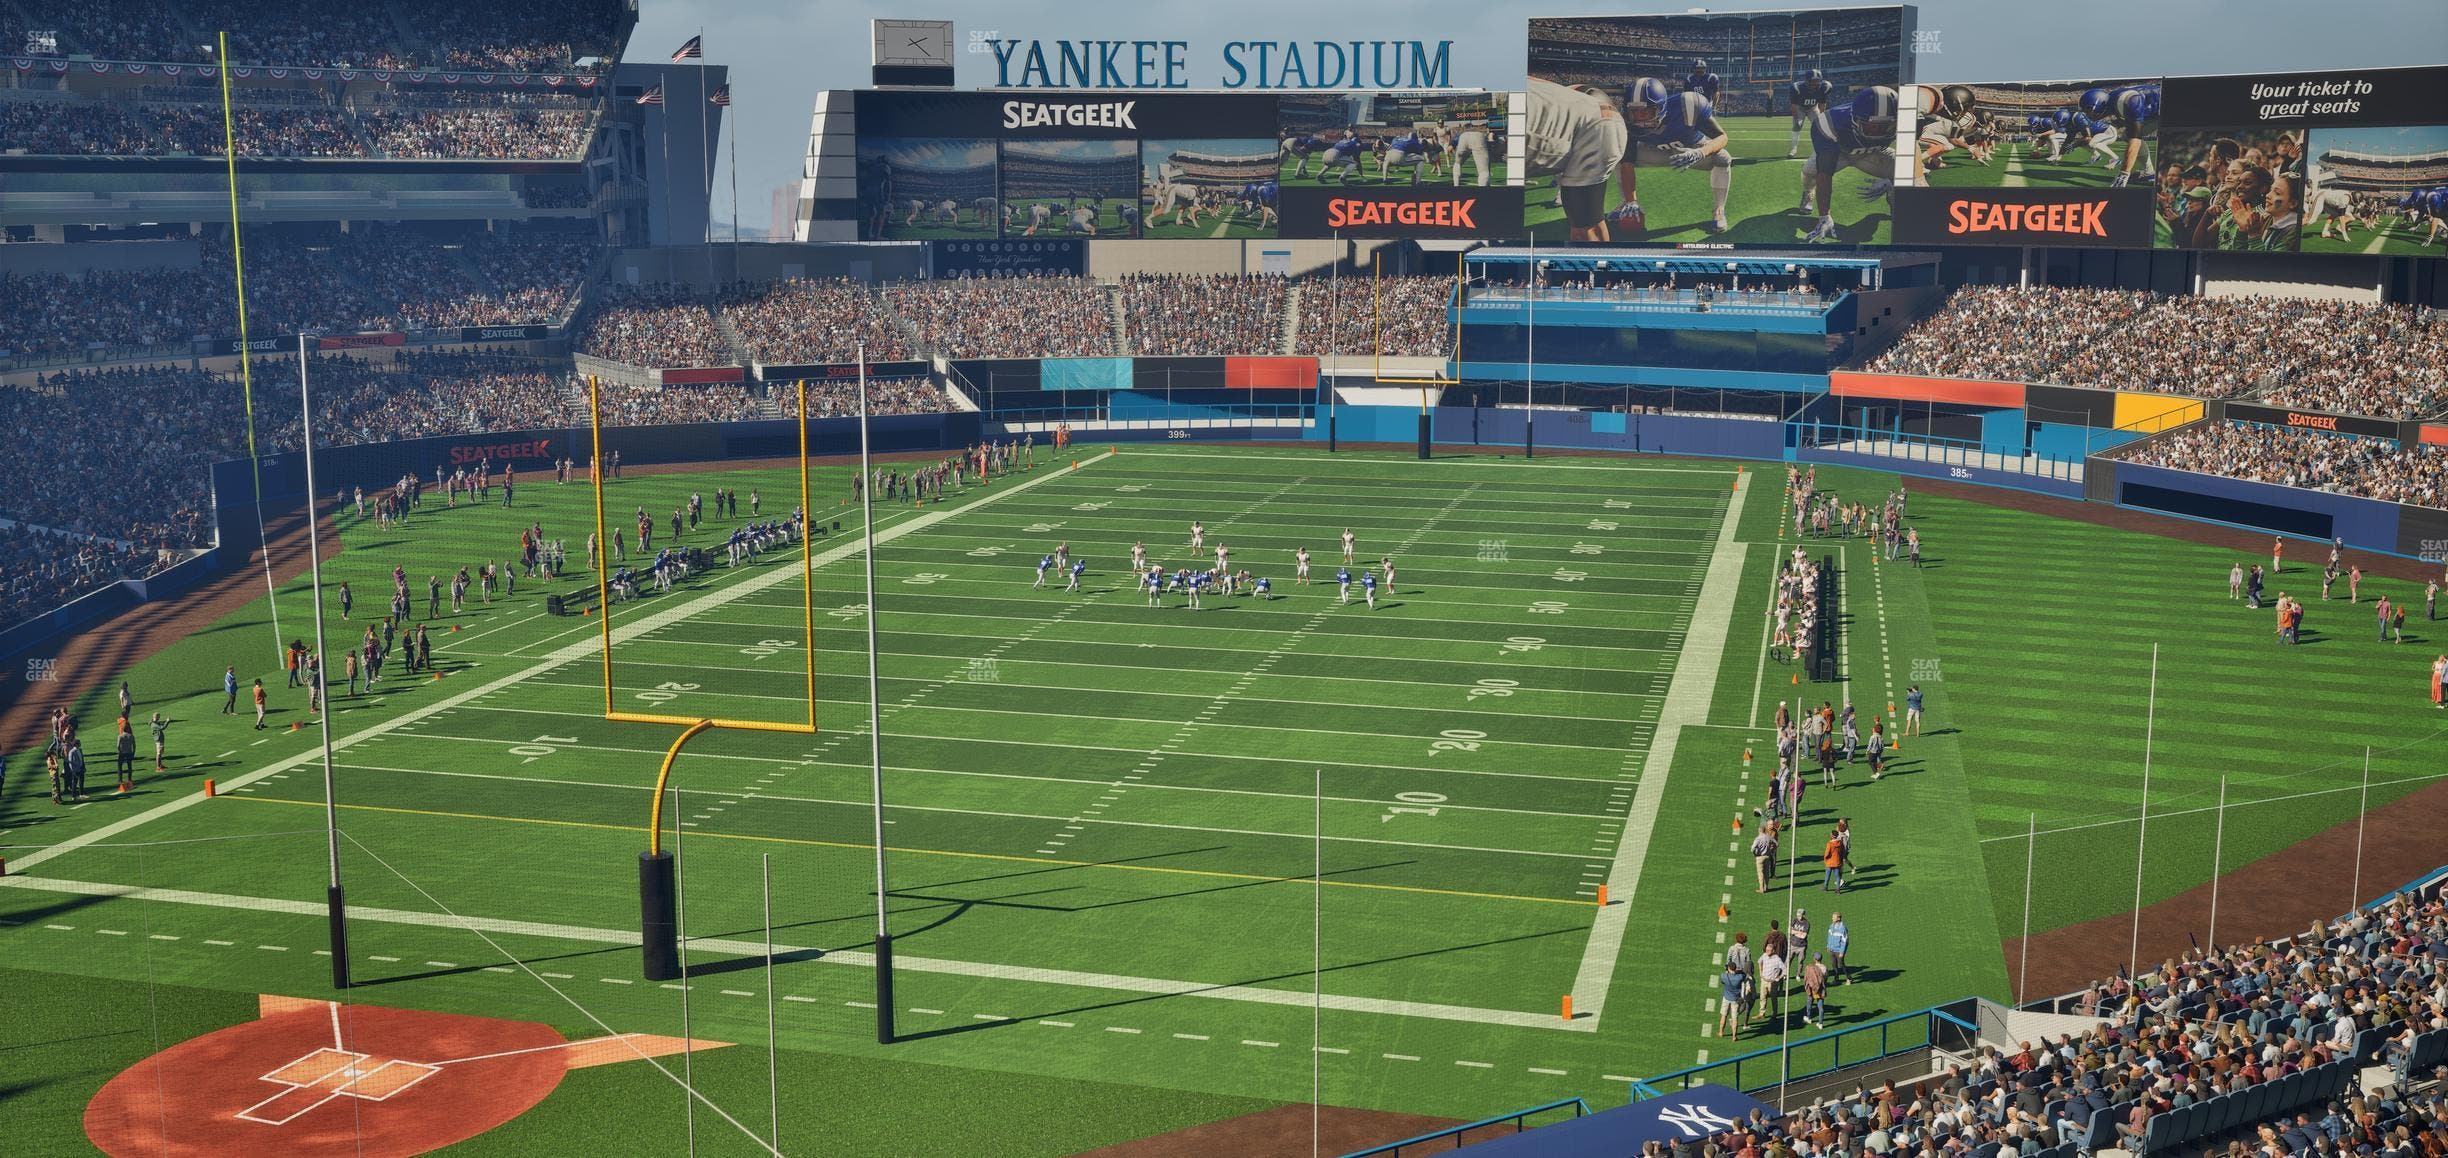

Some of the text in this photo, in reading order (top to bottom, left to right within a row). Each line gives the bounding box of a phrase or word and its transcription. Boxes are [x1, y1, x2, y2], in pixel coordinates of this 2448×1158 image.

[985, 39, 1454, 88] YANKEE STADIUM
[2251, 80, 2373, 100] Your ticket to
[1003, 100, 1136, 130] SEATGEEK
[2259, 99, 2361, 119] great seats
[1328, 198, 1477, 229] SEATGEEK
[1948, 199, 2109, 237] SEATGEEK
[481, 327, 526, 340] SEATGEEK
[2287, 412, 2337, 430] SEATGEEK
[450, 439, 550, 465] SEATGEEK
[1527, 601, 1569, 614] 50
[739, 639, 799, 655] 30
[1502, 636, 1546, 652] 40
[634, 681, 701, 700] 20
[1469, 678, 1520, 697] 30
[508, 734, 579, 756] 10
[1431, 729, 1488, 752] 20
[1388, 791, 1449, 816] 10
